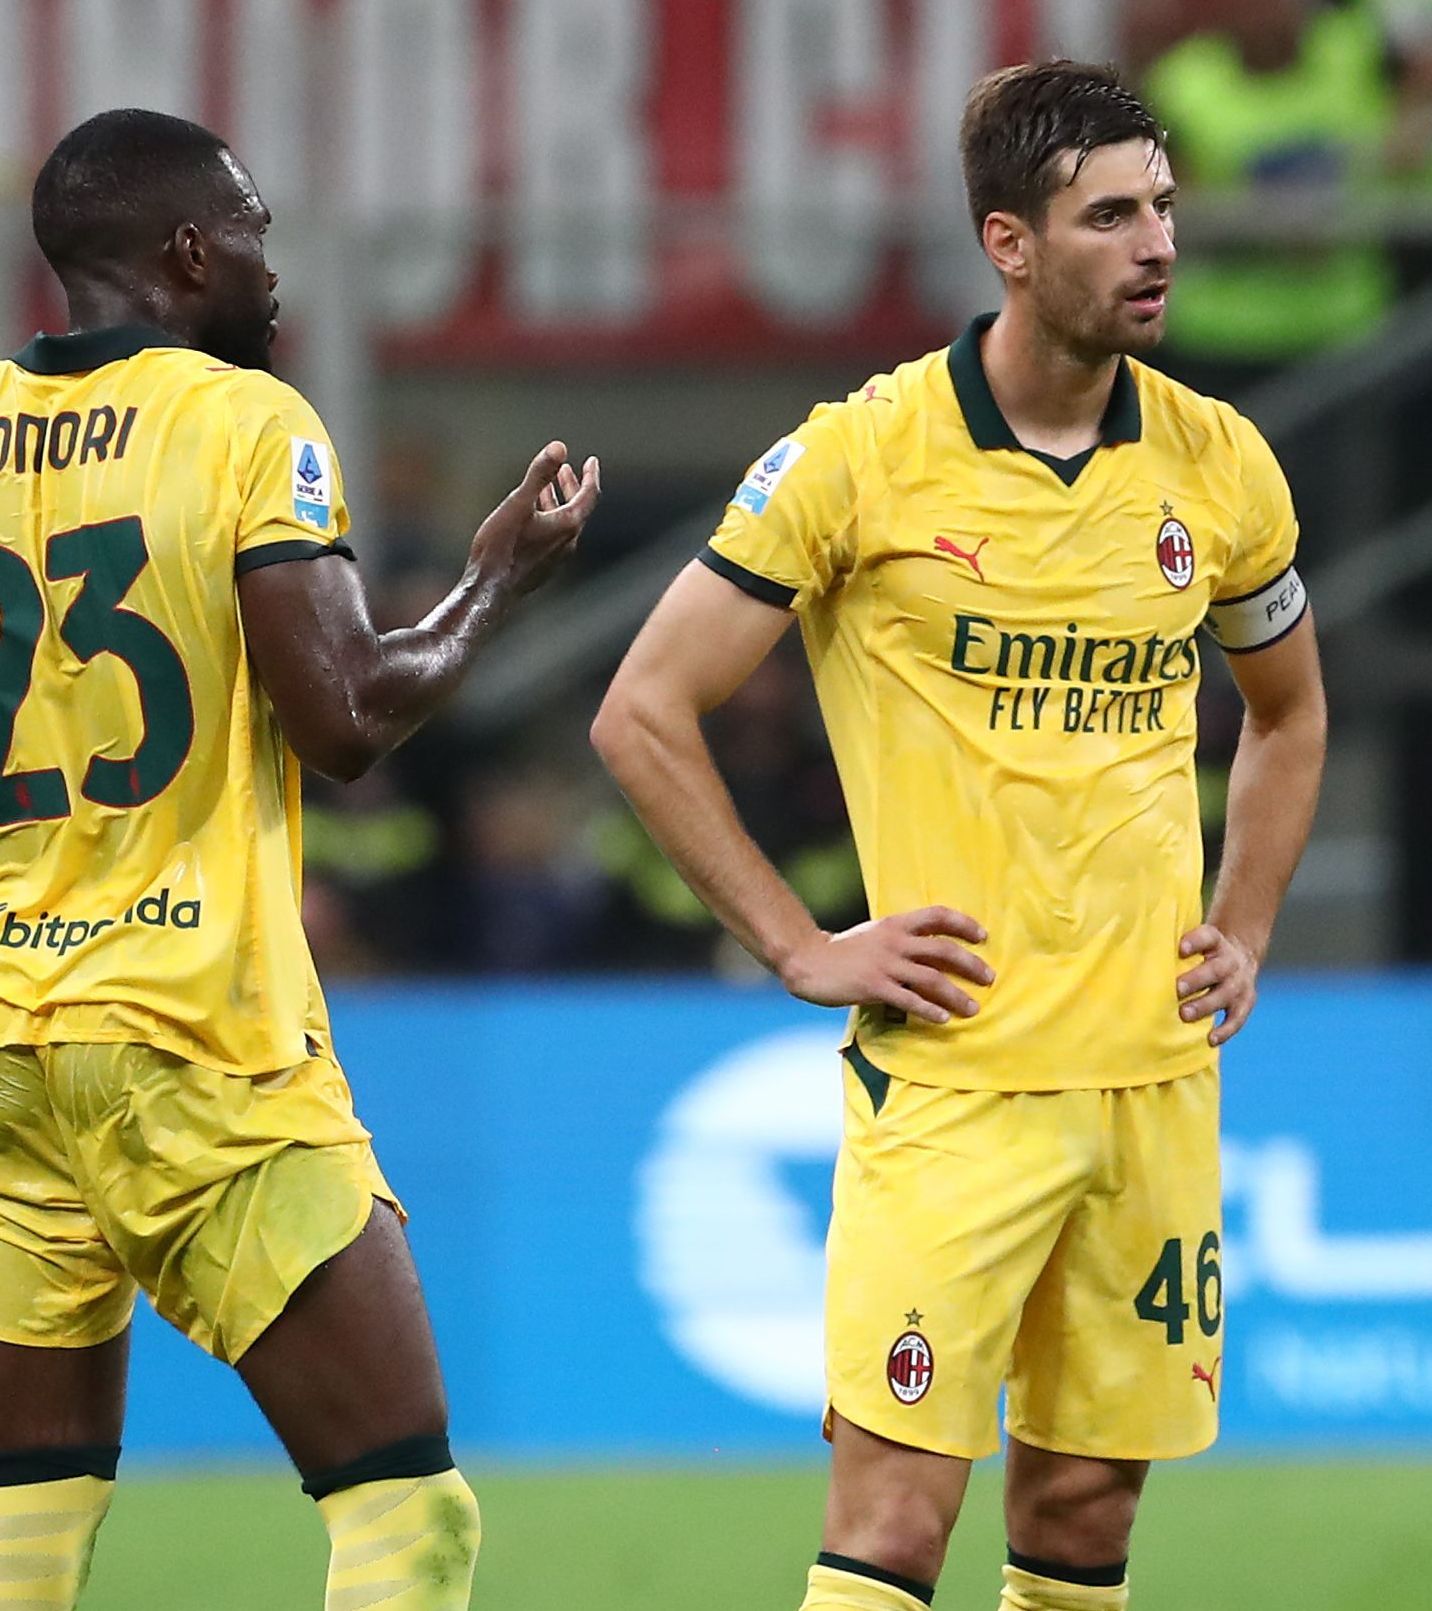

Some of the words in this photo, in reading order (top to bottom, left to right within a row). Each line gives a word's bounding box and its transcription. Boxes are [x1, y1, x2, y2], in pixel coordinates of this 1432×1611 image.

[1266, 580, 1300, 622] PEA
[951, 613, 1196, 684] Emirates
[988, 687, 1052, 731] FLY
[1063, 687, 1165, 733] BETTER
[0, 888, 201, 957] bitpda
[1134, 1230, 1222, 1345] 46
